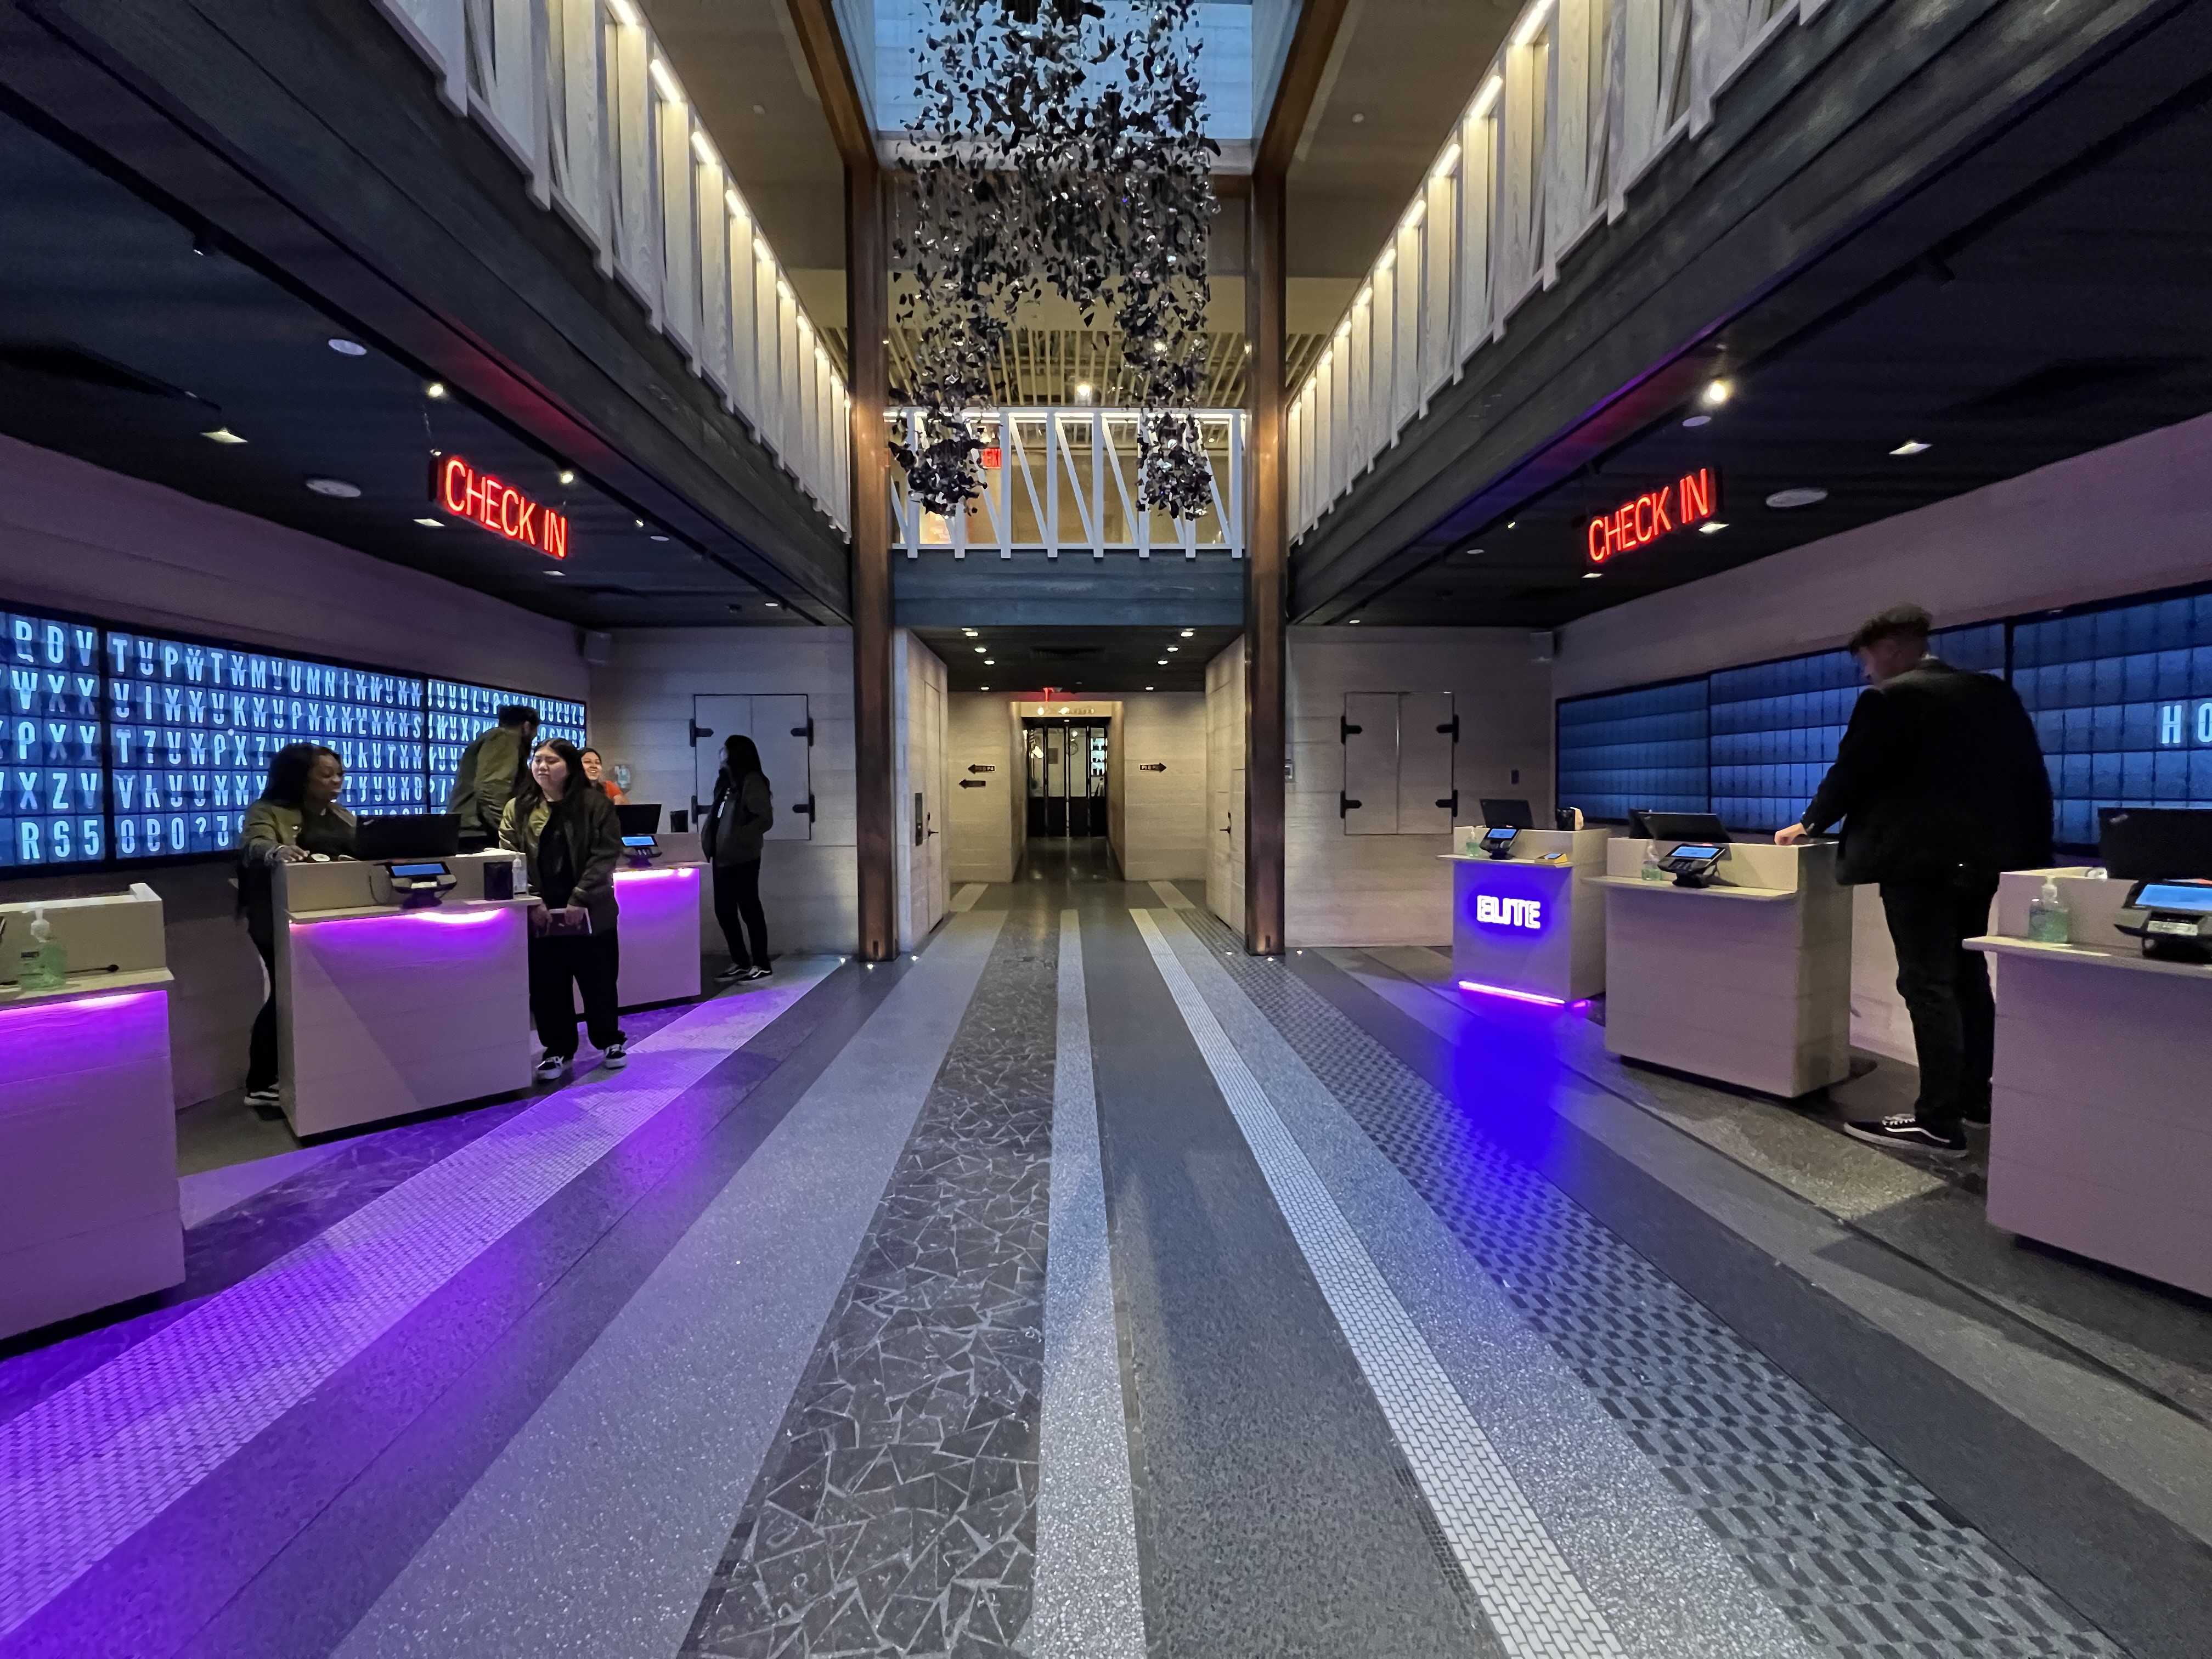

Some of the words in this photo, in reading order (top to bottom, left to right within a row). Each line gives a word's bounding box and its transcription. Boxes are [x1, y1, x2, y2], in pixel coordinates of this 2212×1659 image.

[985, 448, 1001, 466] EXI
[445, 459, 537, 545] CHECK
[544, 509, 567, 558] IN
[1589, 486, 1671, 561] CHECK
[1680, 468, 1708, 523] IN
[2162, 703, 2212, 743] HO
[1477, 895, 1541, 929] ELITE
